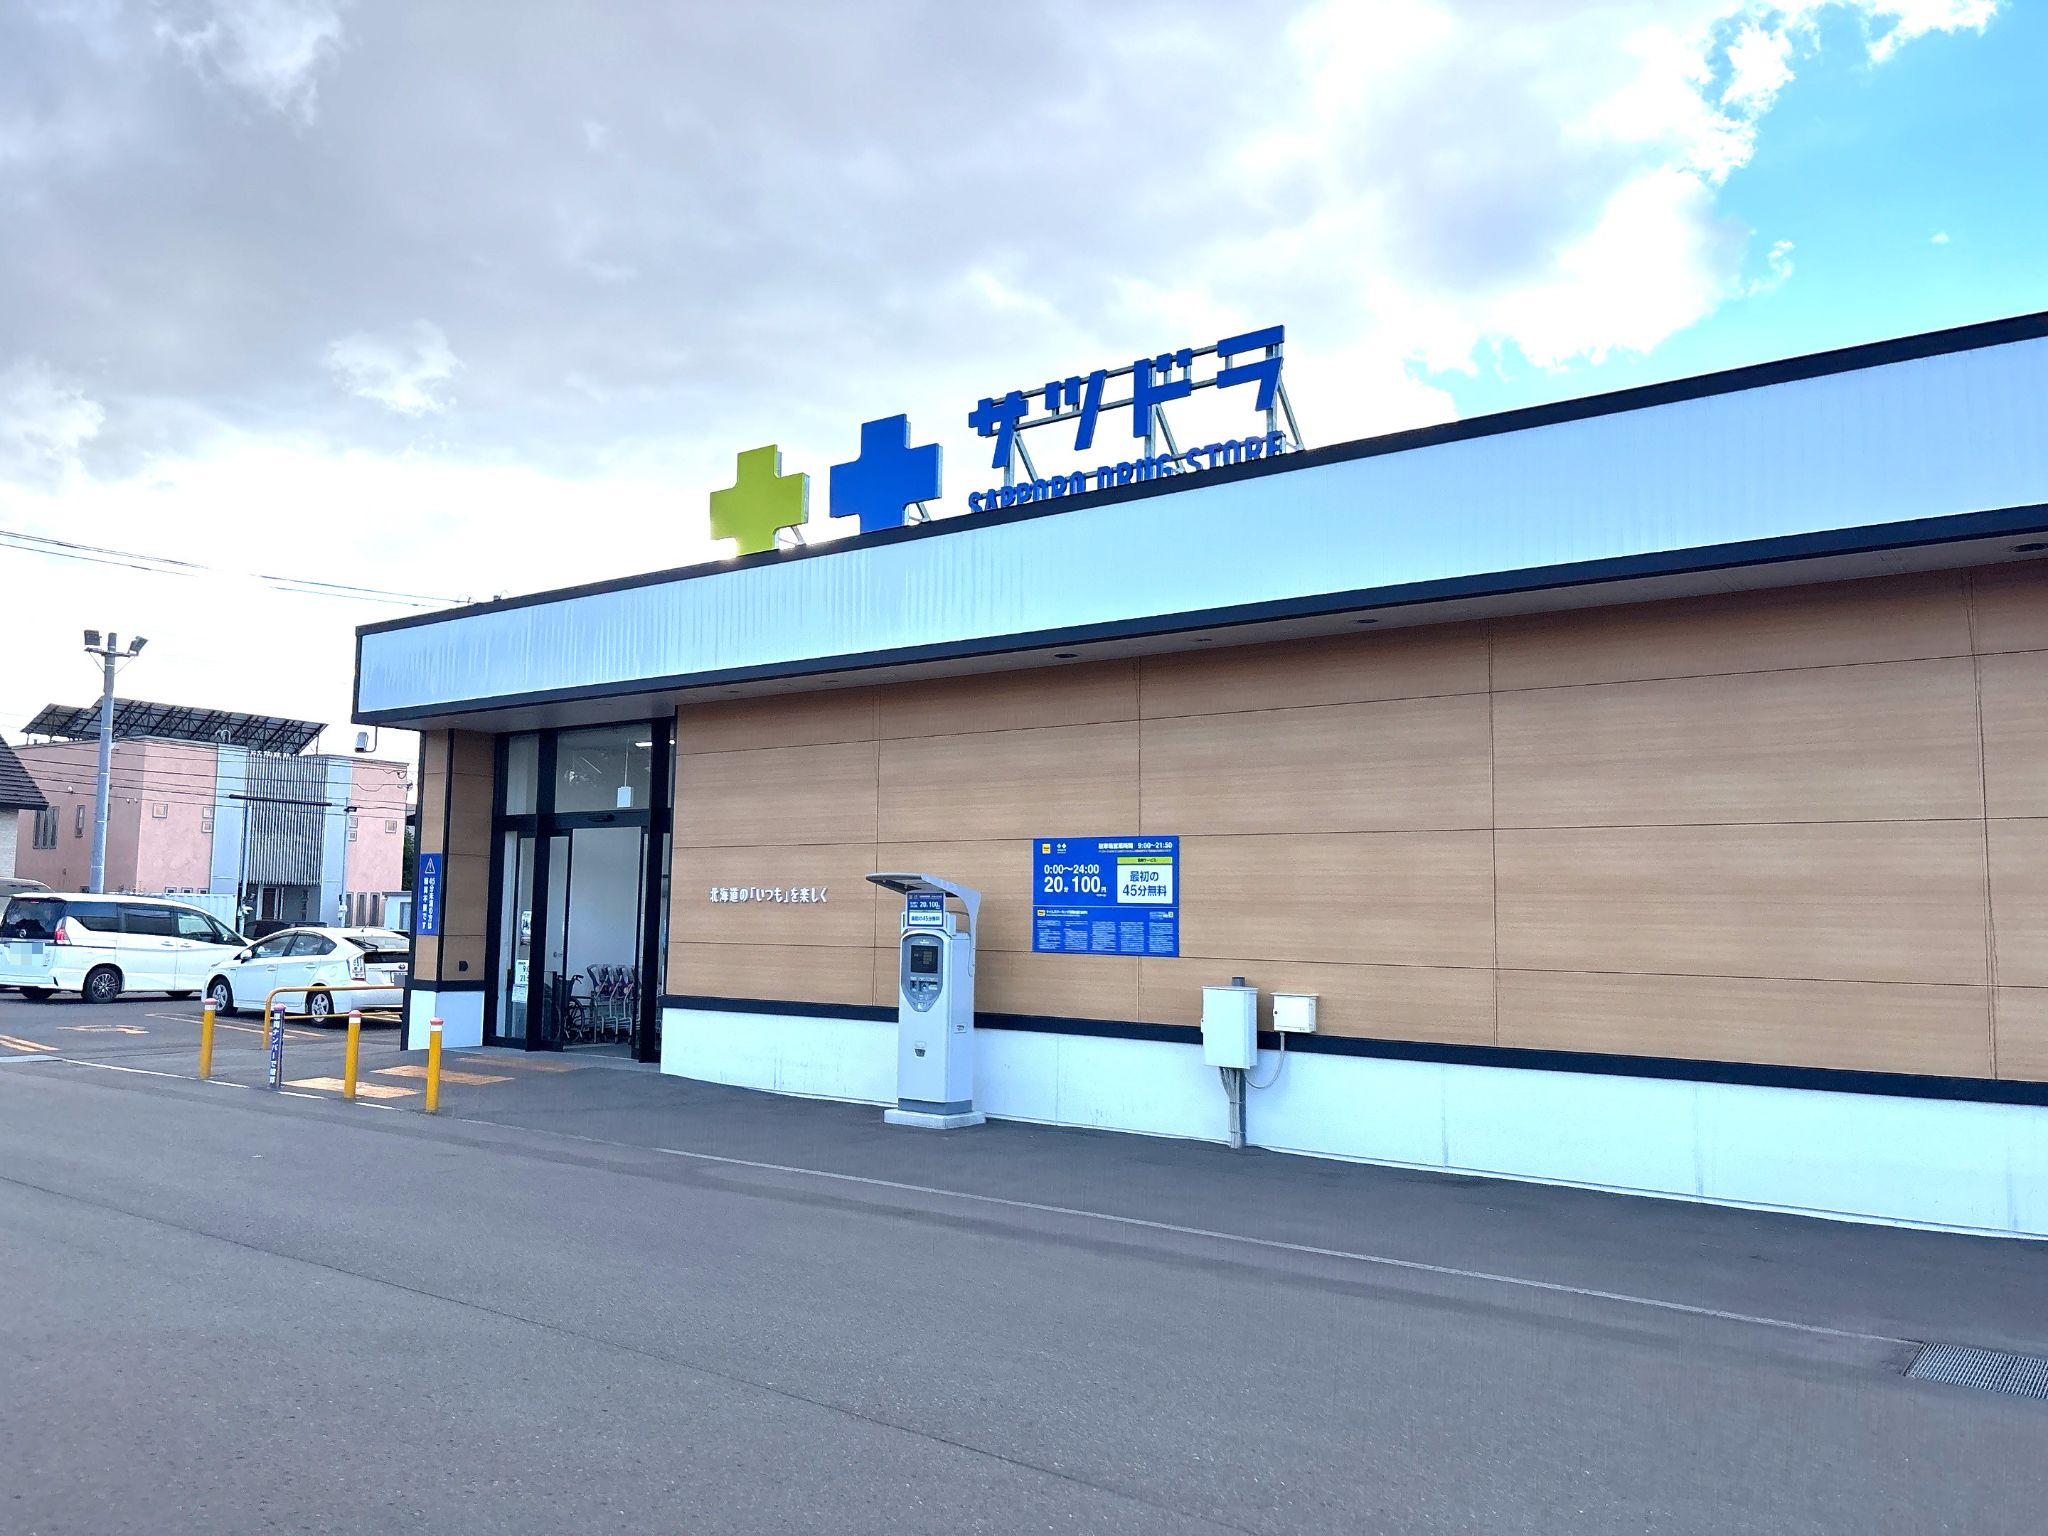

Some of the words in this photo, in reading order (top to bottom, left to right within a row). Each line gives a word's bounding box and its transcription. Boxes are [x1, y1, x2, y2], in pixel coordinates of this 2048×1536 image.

[968, 324, 1285, 469] サツドラ
[968, 471, 1086, 513] SAPPORO
[1097, 453, 1177, 488] DRUG
[1186, 431, 1286, 471] STORE
[1129, 870, 1159, 883] 最初の
[710, 887, 828, 903] 北海道の「いつも」を楽しく
[1122, 884, 1167, 897] 45分無料
